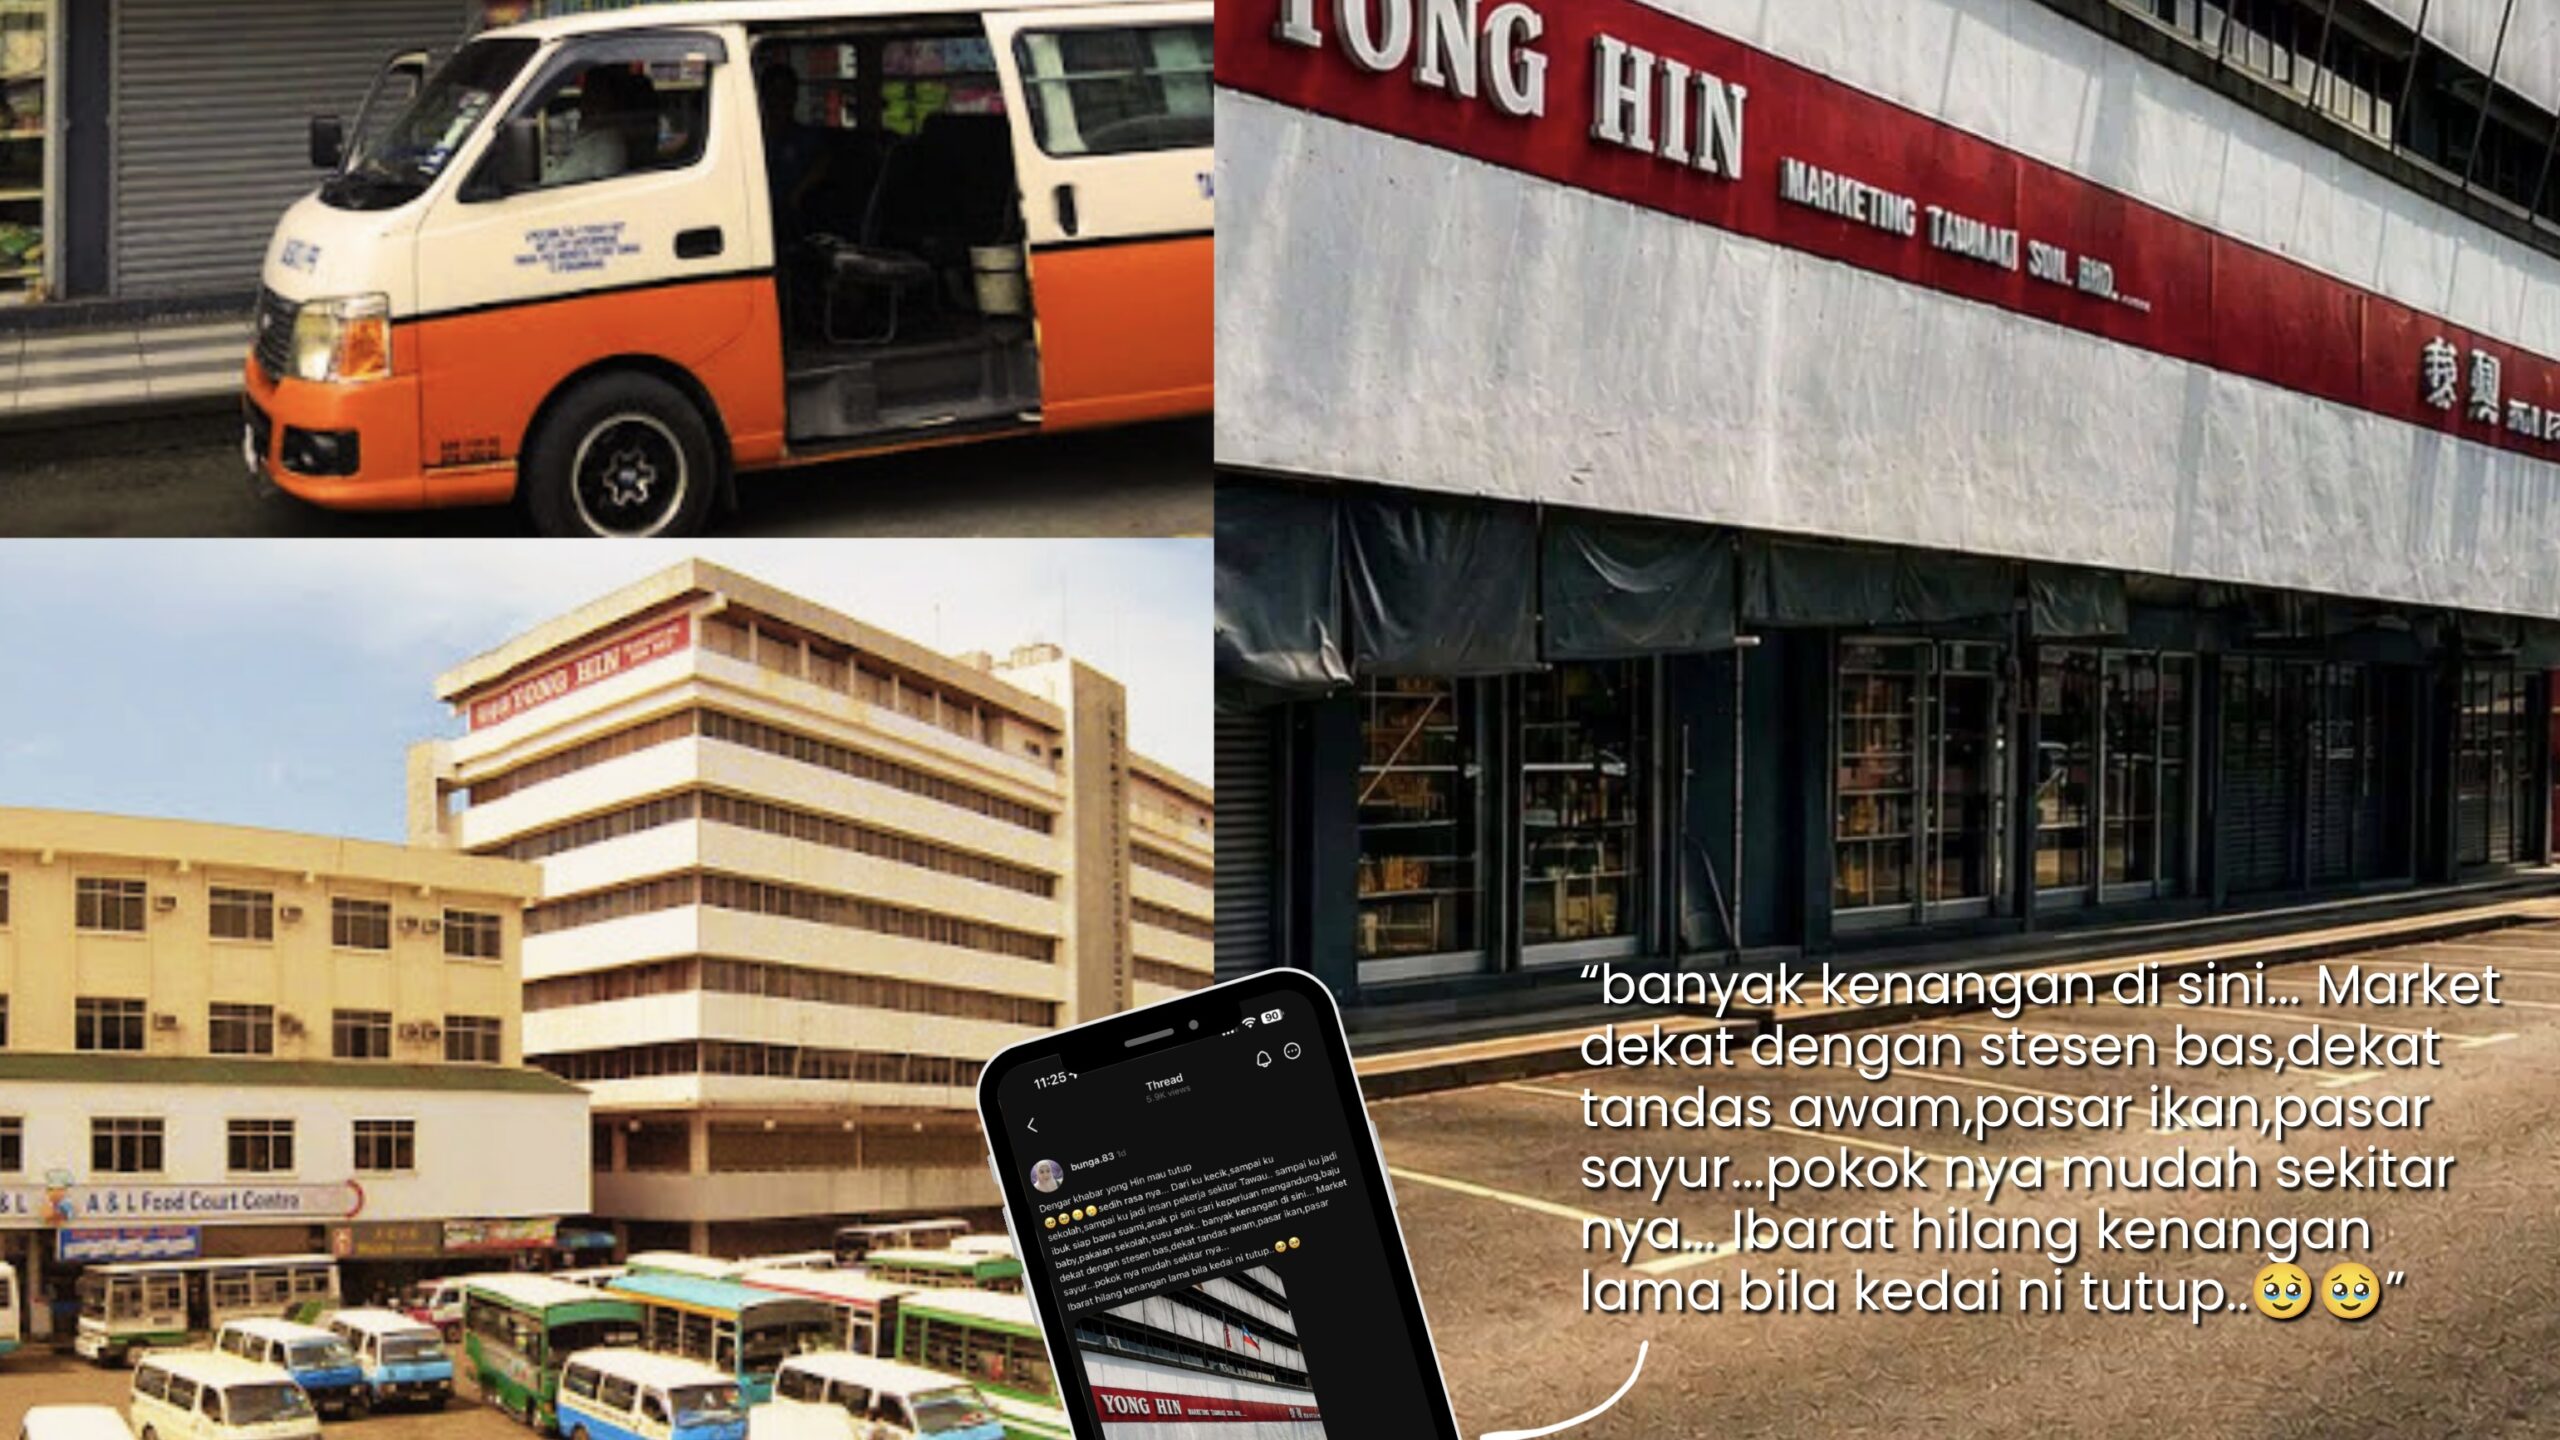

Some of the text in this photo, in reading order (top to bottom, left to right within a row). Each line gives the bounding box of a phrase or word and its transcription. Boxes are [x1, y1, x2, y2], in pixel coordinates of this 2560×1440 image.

[1592, 33, 1747, 180] HIN
[1780, 156, 1917, 238] MARKETING
[577, 646, 620, 685] HIN
[1265, 1011, 1279, 1022] 90
[1034, 1072, 1067, 1089] 11:25
[1145, 1073, 1184, 1091] Thread
[1146, 1086, 1192, 1103] 5.9K views
[1070, 1152, 1115, 1171] bunga.83
[1099, 1200, 1123, 1212] sedih
[1124, 1195, 1144, 1204] rasa
[1145, 1189, 1170, 1199] nya...
[1171, 1179, 1190, 1191] Dari
[1191, 1177, 1203, 1185] ku
[1204, 1159, 1262, 1181] kecik,sampai
[87, 1199, 98, 1212] A
[106, 1197, 120, 1212] &
[127, 1196, 136, 1211] L
[142, 1194, 185, 1212] Food
[190, 1193, 238, 1211] Court
[1039, 1164, 1192, 1213] Dengar khabar yong Hin mau tutup
[1048, 1215, 1116, 1241] sekolah,sampai
[1130, 1207, 1147, 1220] jadi
[1148, 1201, 1172, 1212] insan
[1173, 1191, 1207, 1207] pekerja
[1208, 1182, 1238, 1195] sekitar
[1239, 1173, 1274, 1185] Tawau..
[1275, 1160, 1307, 1176] sampai
[1308, 1158, 1320, 1166] ku
[1321, 1152, 1338, 1165] jadi
[1051, 1167, 1341, 1255] ibuk siap bawa suami,anak pi sini cari keperluan mengandung,baju
[1055, 1179, 1348, 1269] baby,pakaian sekolah,susu anak.. banyak kenangan di sini... Market
[1060, 1200, 1329, 1282] dekat dengan stesen bas,dekat tandas awam,pasar ikan,pasar
[1064, 1246, 1230, 1296] sayur...pokok nya mudah sekitar nya...
[1067, 1248, 1275, 1311] Ibarat hilang kenangan lama bila kedai ni tutup..
[1101, 1394, 1150, 1416] YONG
[1155, 1398, 1182, 1415] HIN
